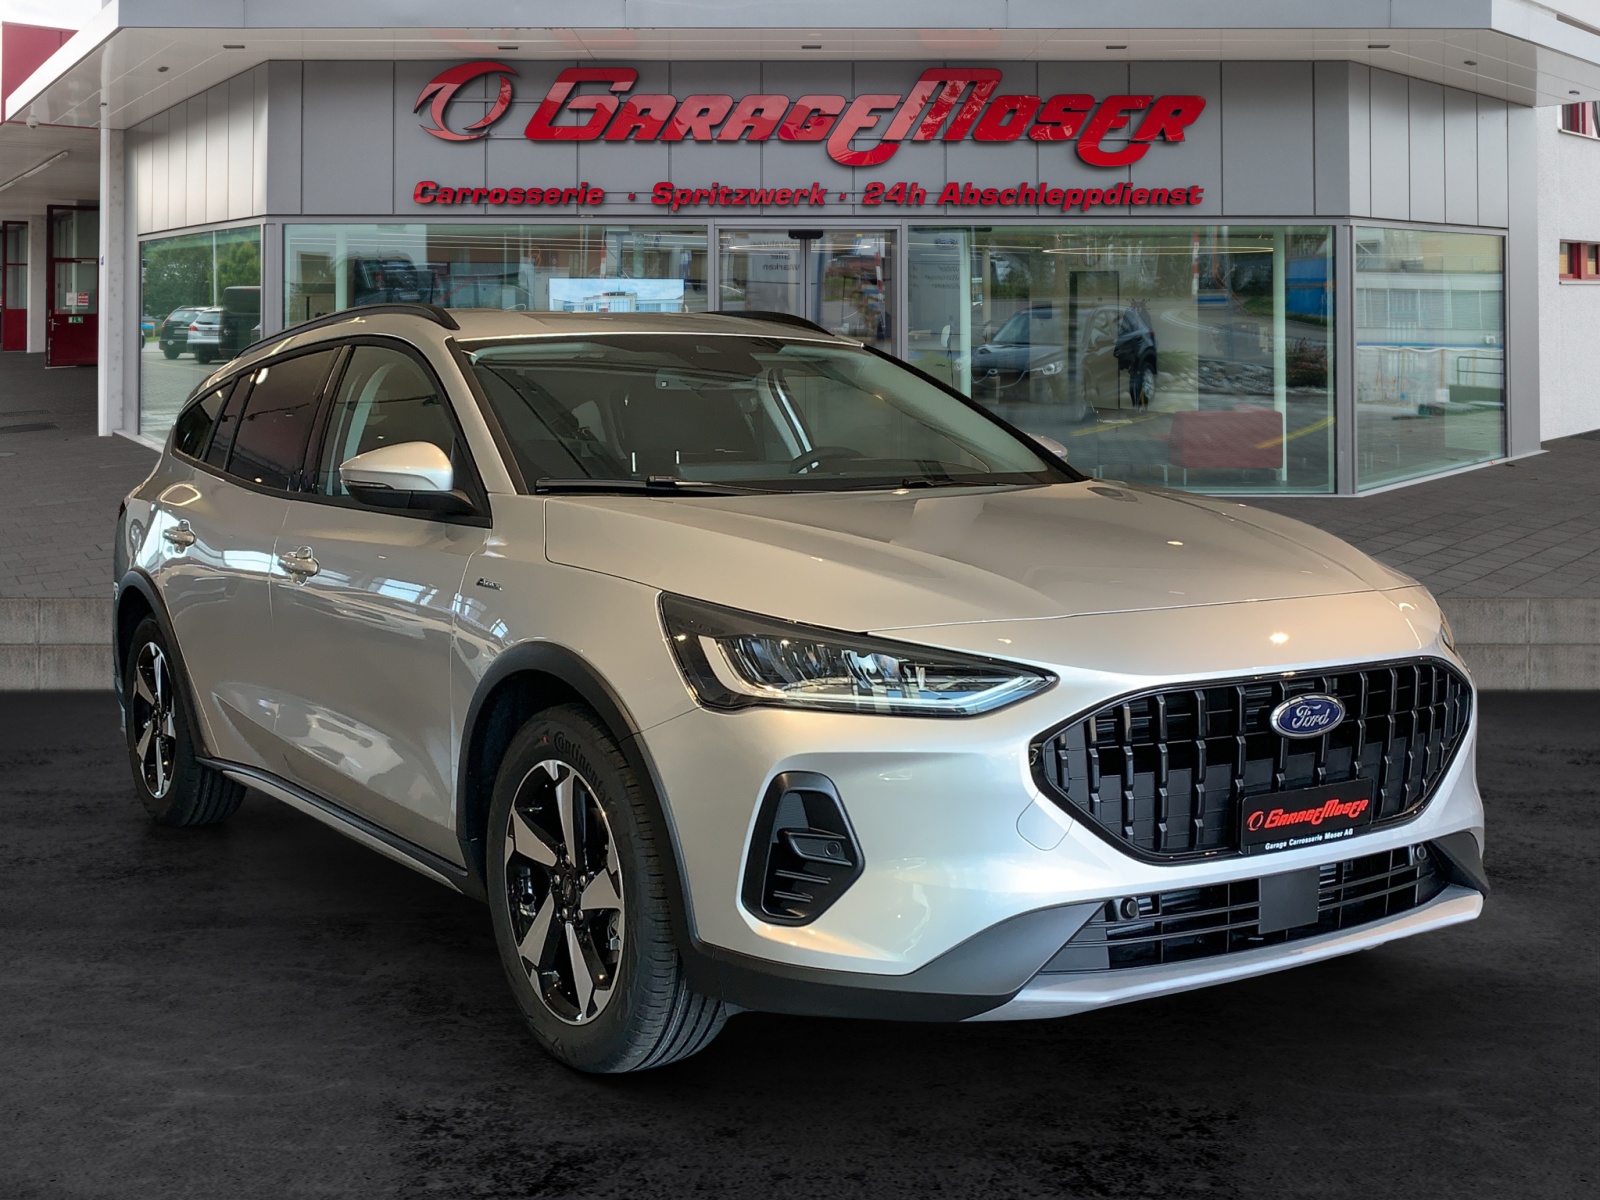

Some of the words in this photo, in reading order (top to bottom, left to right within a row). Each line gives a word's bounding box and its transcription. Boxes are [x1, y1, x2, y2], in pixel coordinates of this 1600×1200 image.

[414, 181, 604, 204] Carrosserie
[652, 182, 826, 210] Spritzwerk
[863, 182, 926, 204] 24h
[938, 182, 1203, 211] Abschleppdienst
[1292, 704, 1330, 728] Ford
[1265, 839, 1287, 850] Garage
[1324, 832, 1343, 840] Moser
[1343, 828, 1354, 836] AG
